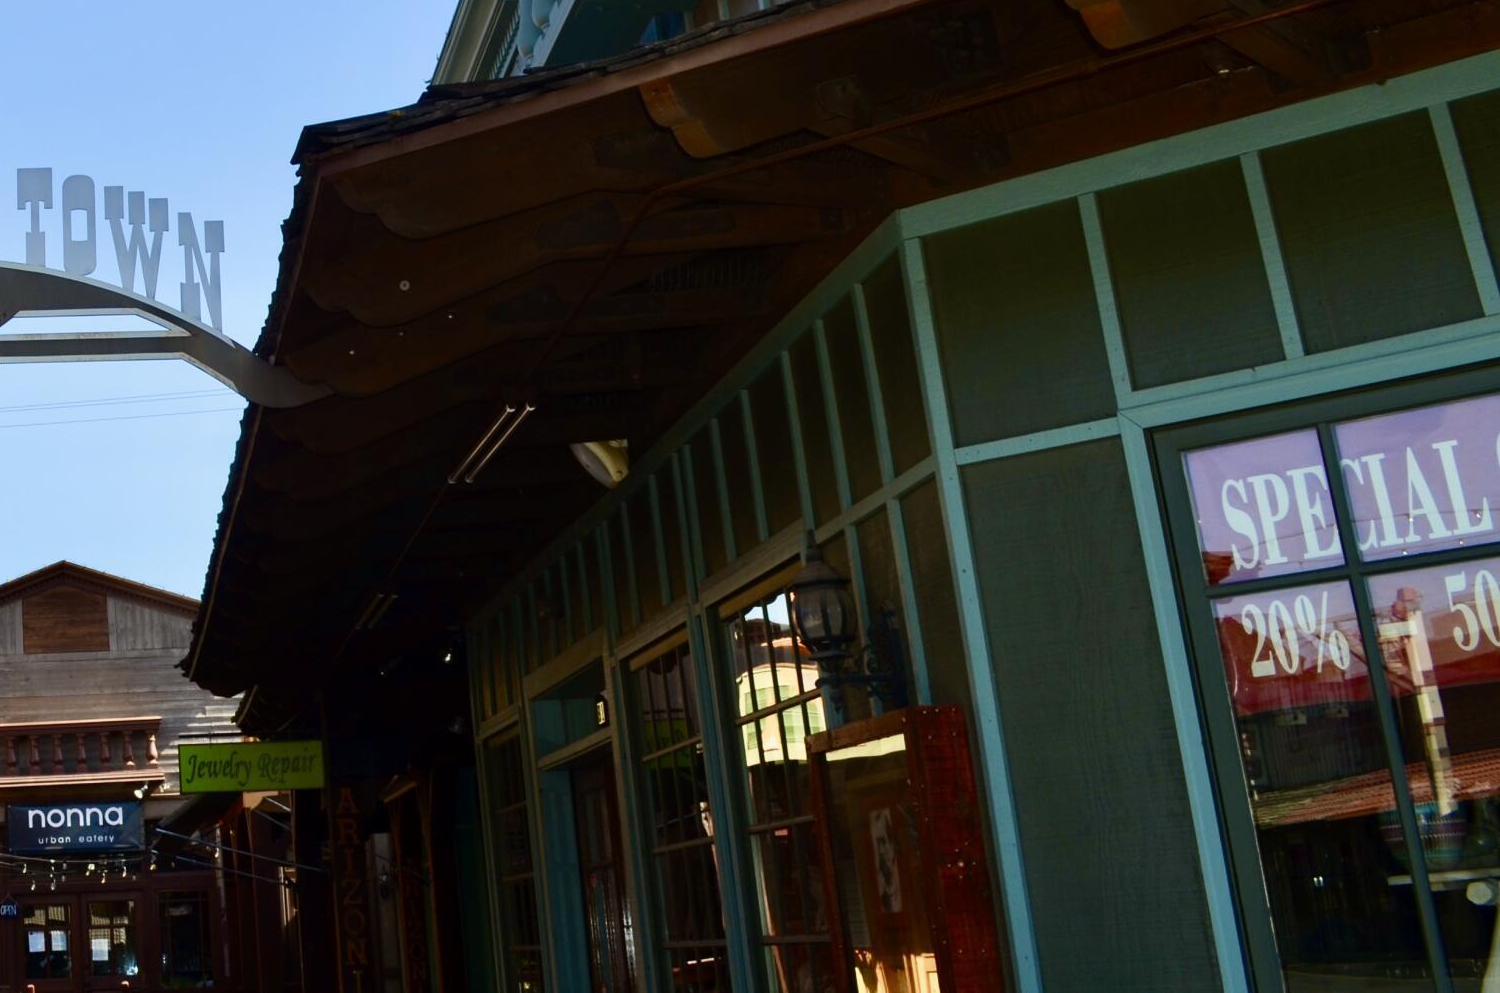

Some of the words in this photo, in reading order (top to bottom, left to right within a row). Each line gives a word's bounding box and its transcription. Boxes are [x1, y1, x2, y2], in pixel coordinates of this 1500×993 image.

[16, 167, 225, 334] TOWN
[1241, 590, 1350, 678] 20%
[186, 750, 252, 787] Jewelry
[257, 746, 318, 784] Repair
[28, 806, 124, 829] nonna
[38, 835, 71, 844] urban
[78, 834, 115, 843] eatery
[0, 904, 17, 916] OPEN
